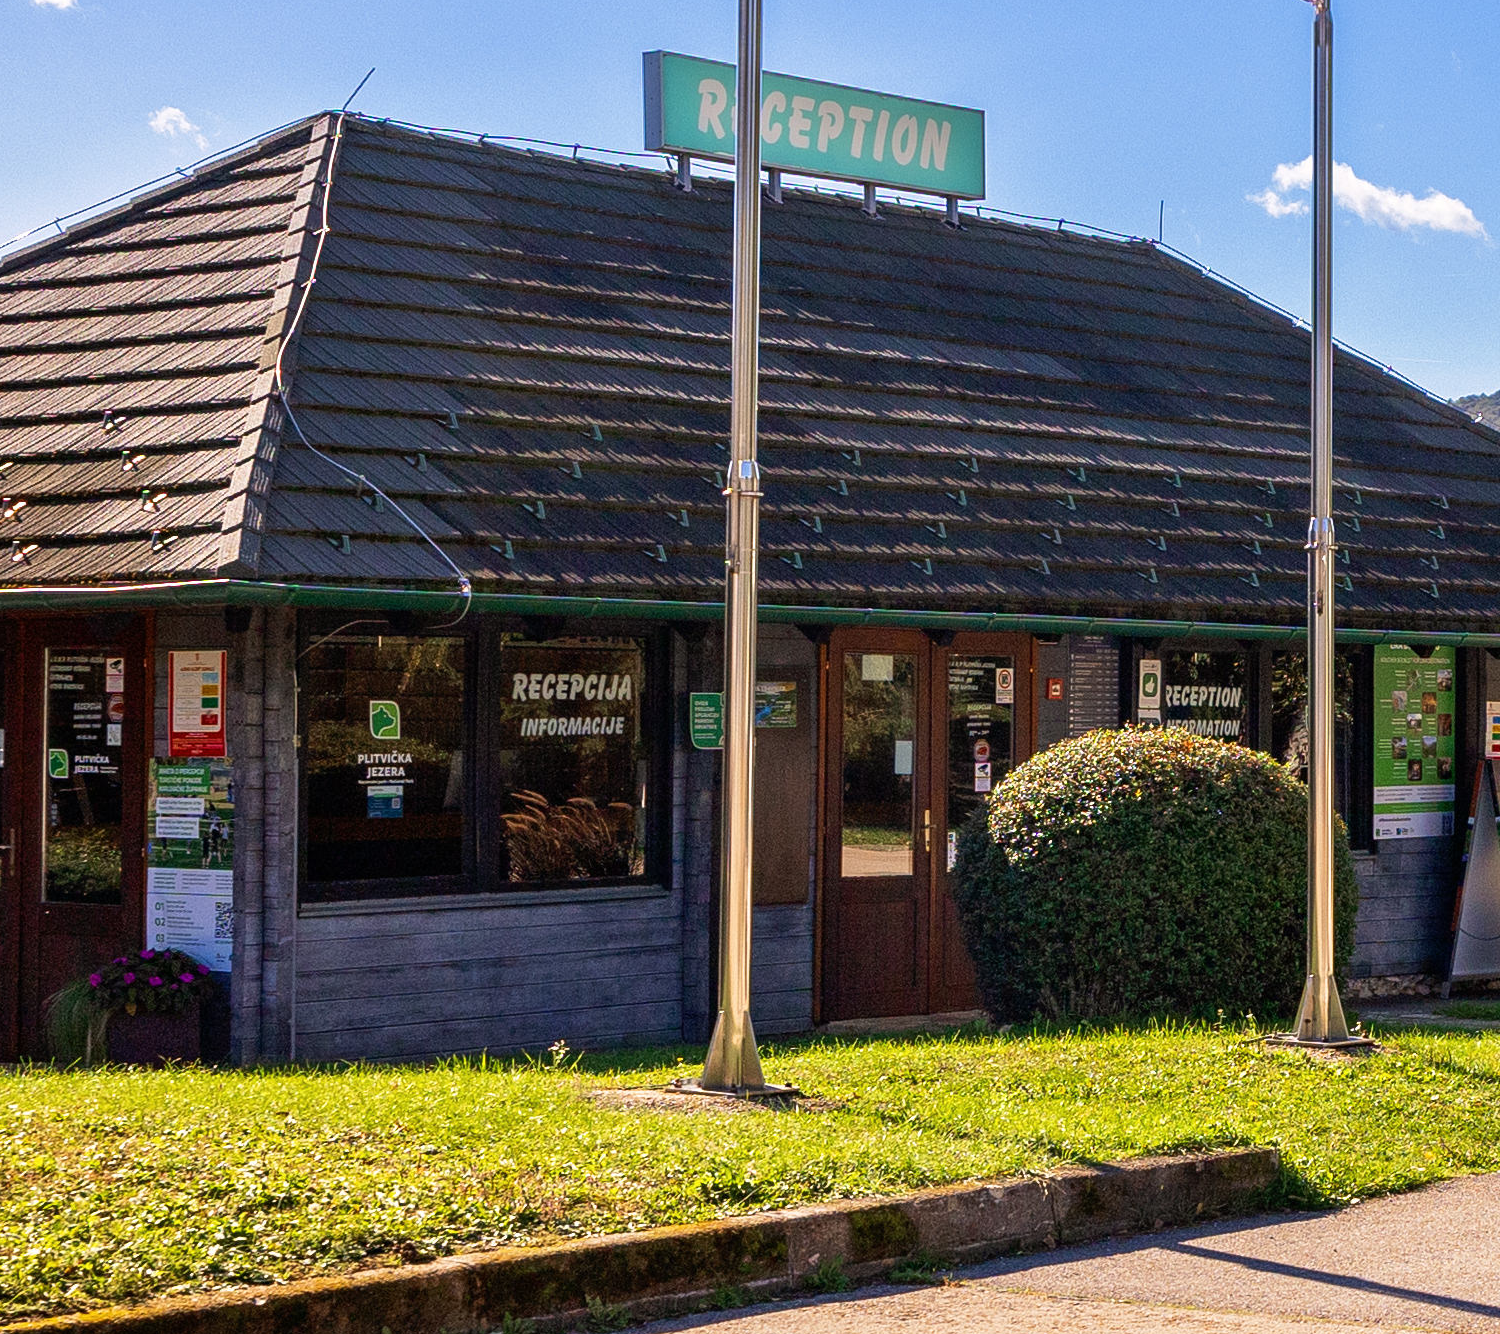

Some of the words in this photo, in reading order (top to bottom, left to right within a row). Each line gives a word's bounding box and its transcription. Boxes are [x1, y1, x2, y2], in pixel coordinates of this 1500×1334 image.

[697, 78, 952, 171] RCEPTION
[512, 672, 632, 702] RECEPCIJA
[520, 717, 625, 736] INFORMACIJE
[1166, 719, 1241, 736] NFORMATION
[357, 750, 413, 764] PLITVIČKA
[366, 767, 406, 779] JEZERA
